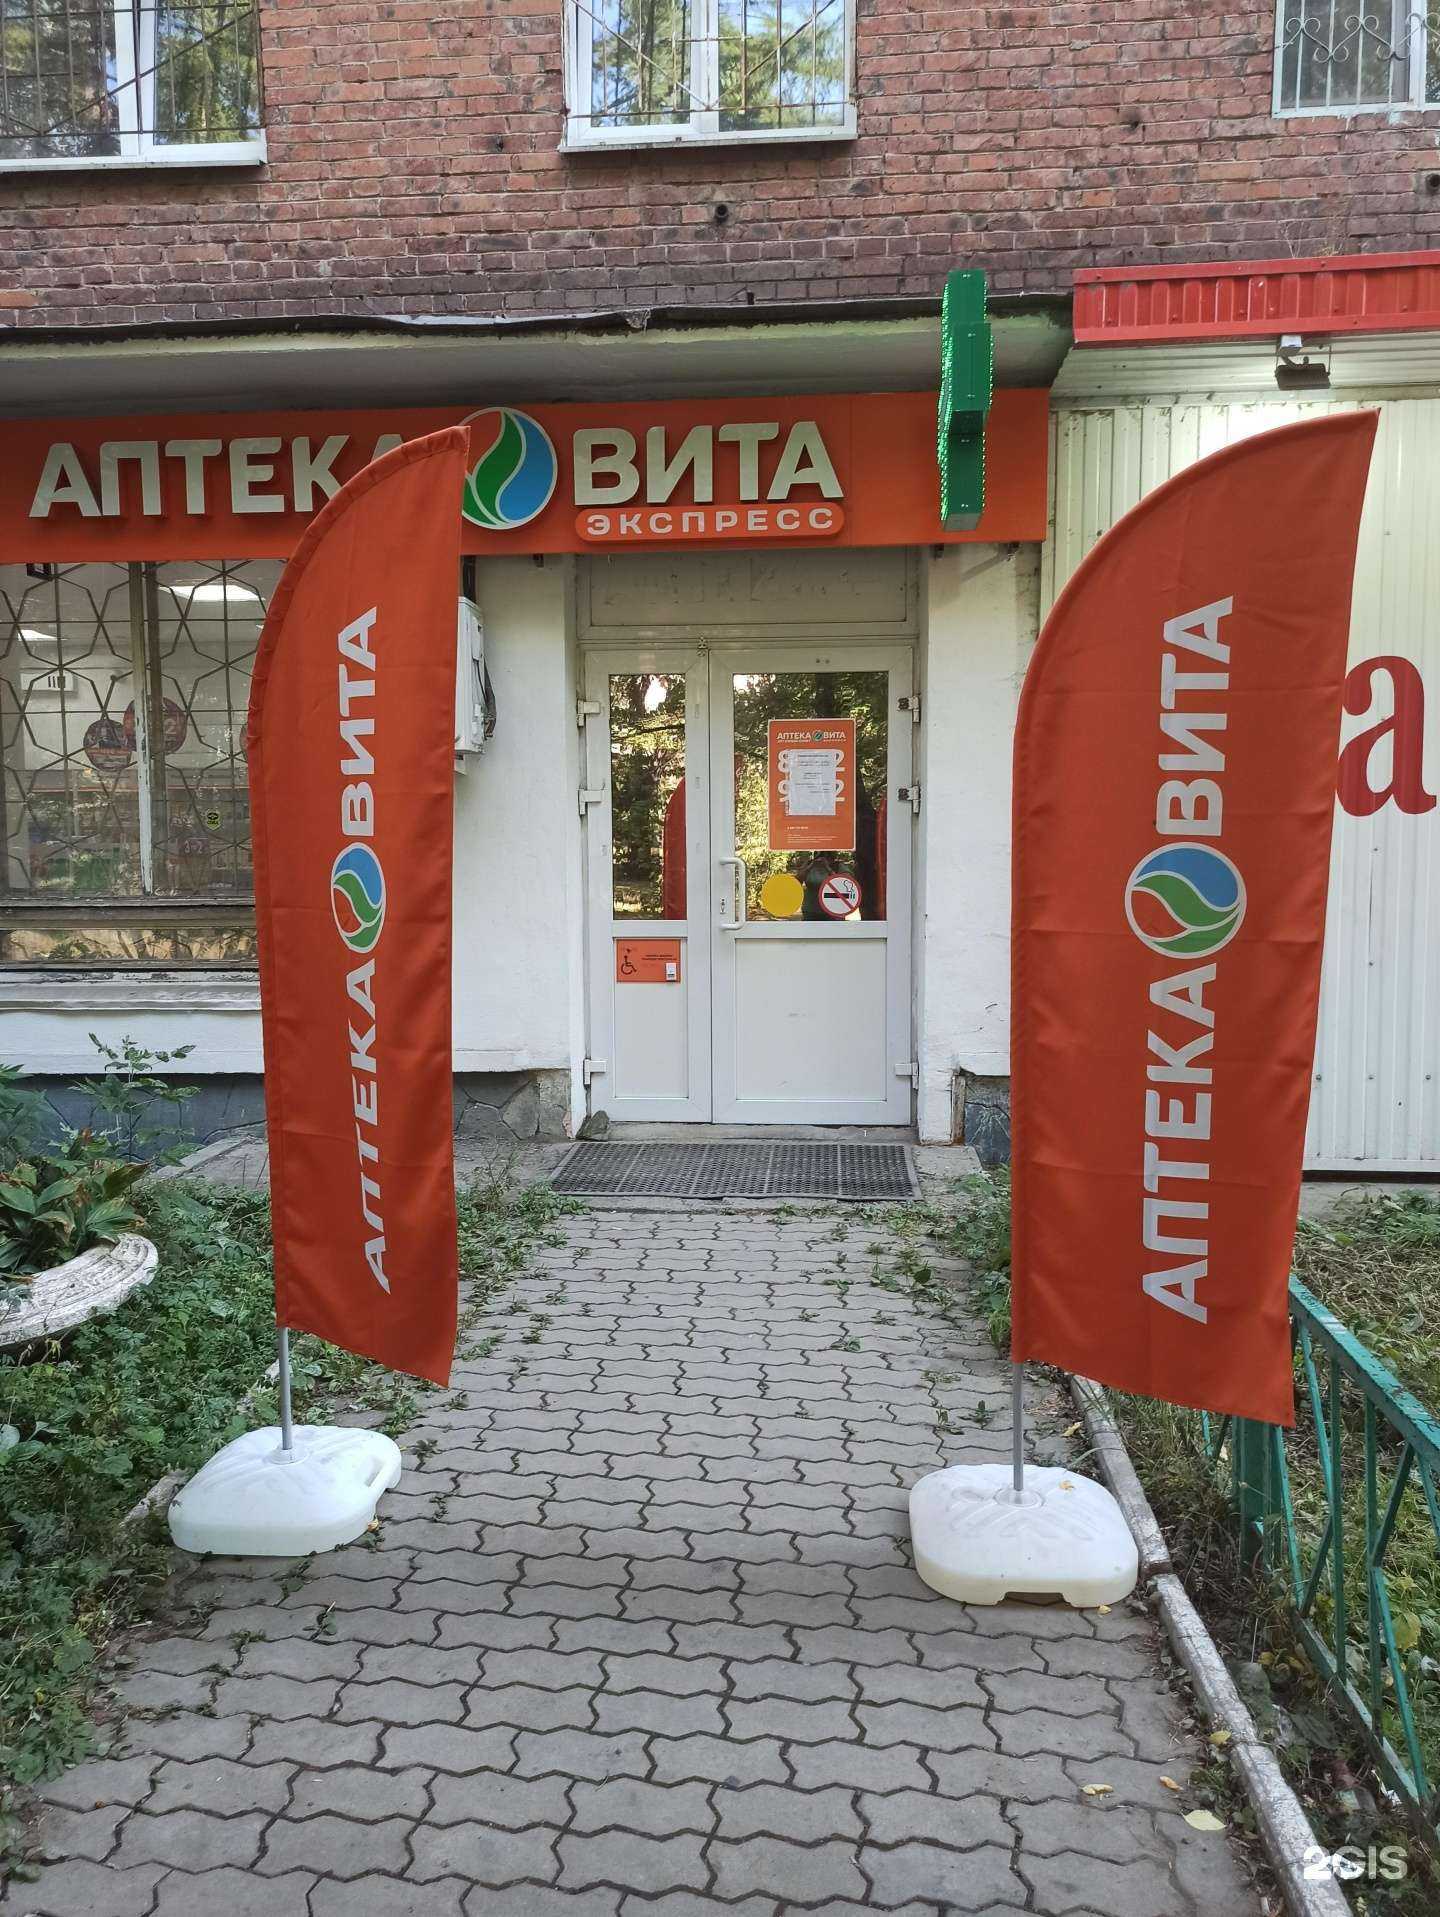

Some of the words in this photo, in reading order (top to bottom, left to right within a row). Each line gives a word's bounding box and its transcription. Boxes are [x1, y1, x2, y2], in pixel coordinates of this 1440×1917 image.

[29, 434, 403, 517] АПТЕК
[573, 421, 844, 506] ВИТА
[587, 507, 833, 536] ЭКСПРЕСС
[338, 606, 377, 838] ВИТА
[776, 732, 812, 740] АПТЕКА
[823, 731, 846, 739] ВИТА
[1156, 596, 1233, 836] ВИТА
[345, 958, 391, 1294] АПТЕКА
[1143, 963, 1217, 1324] АПТЕКА
